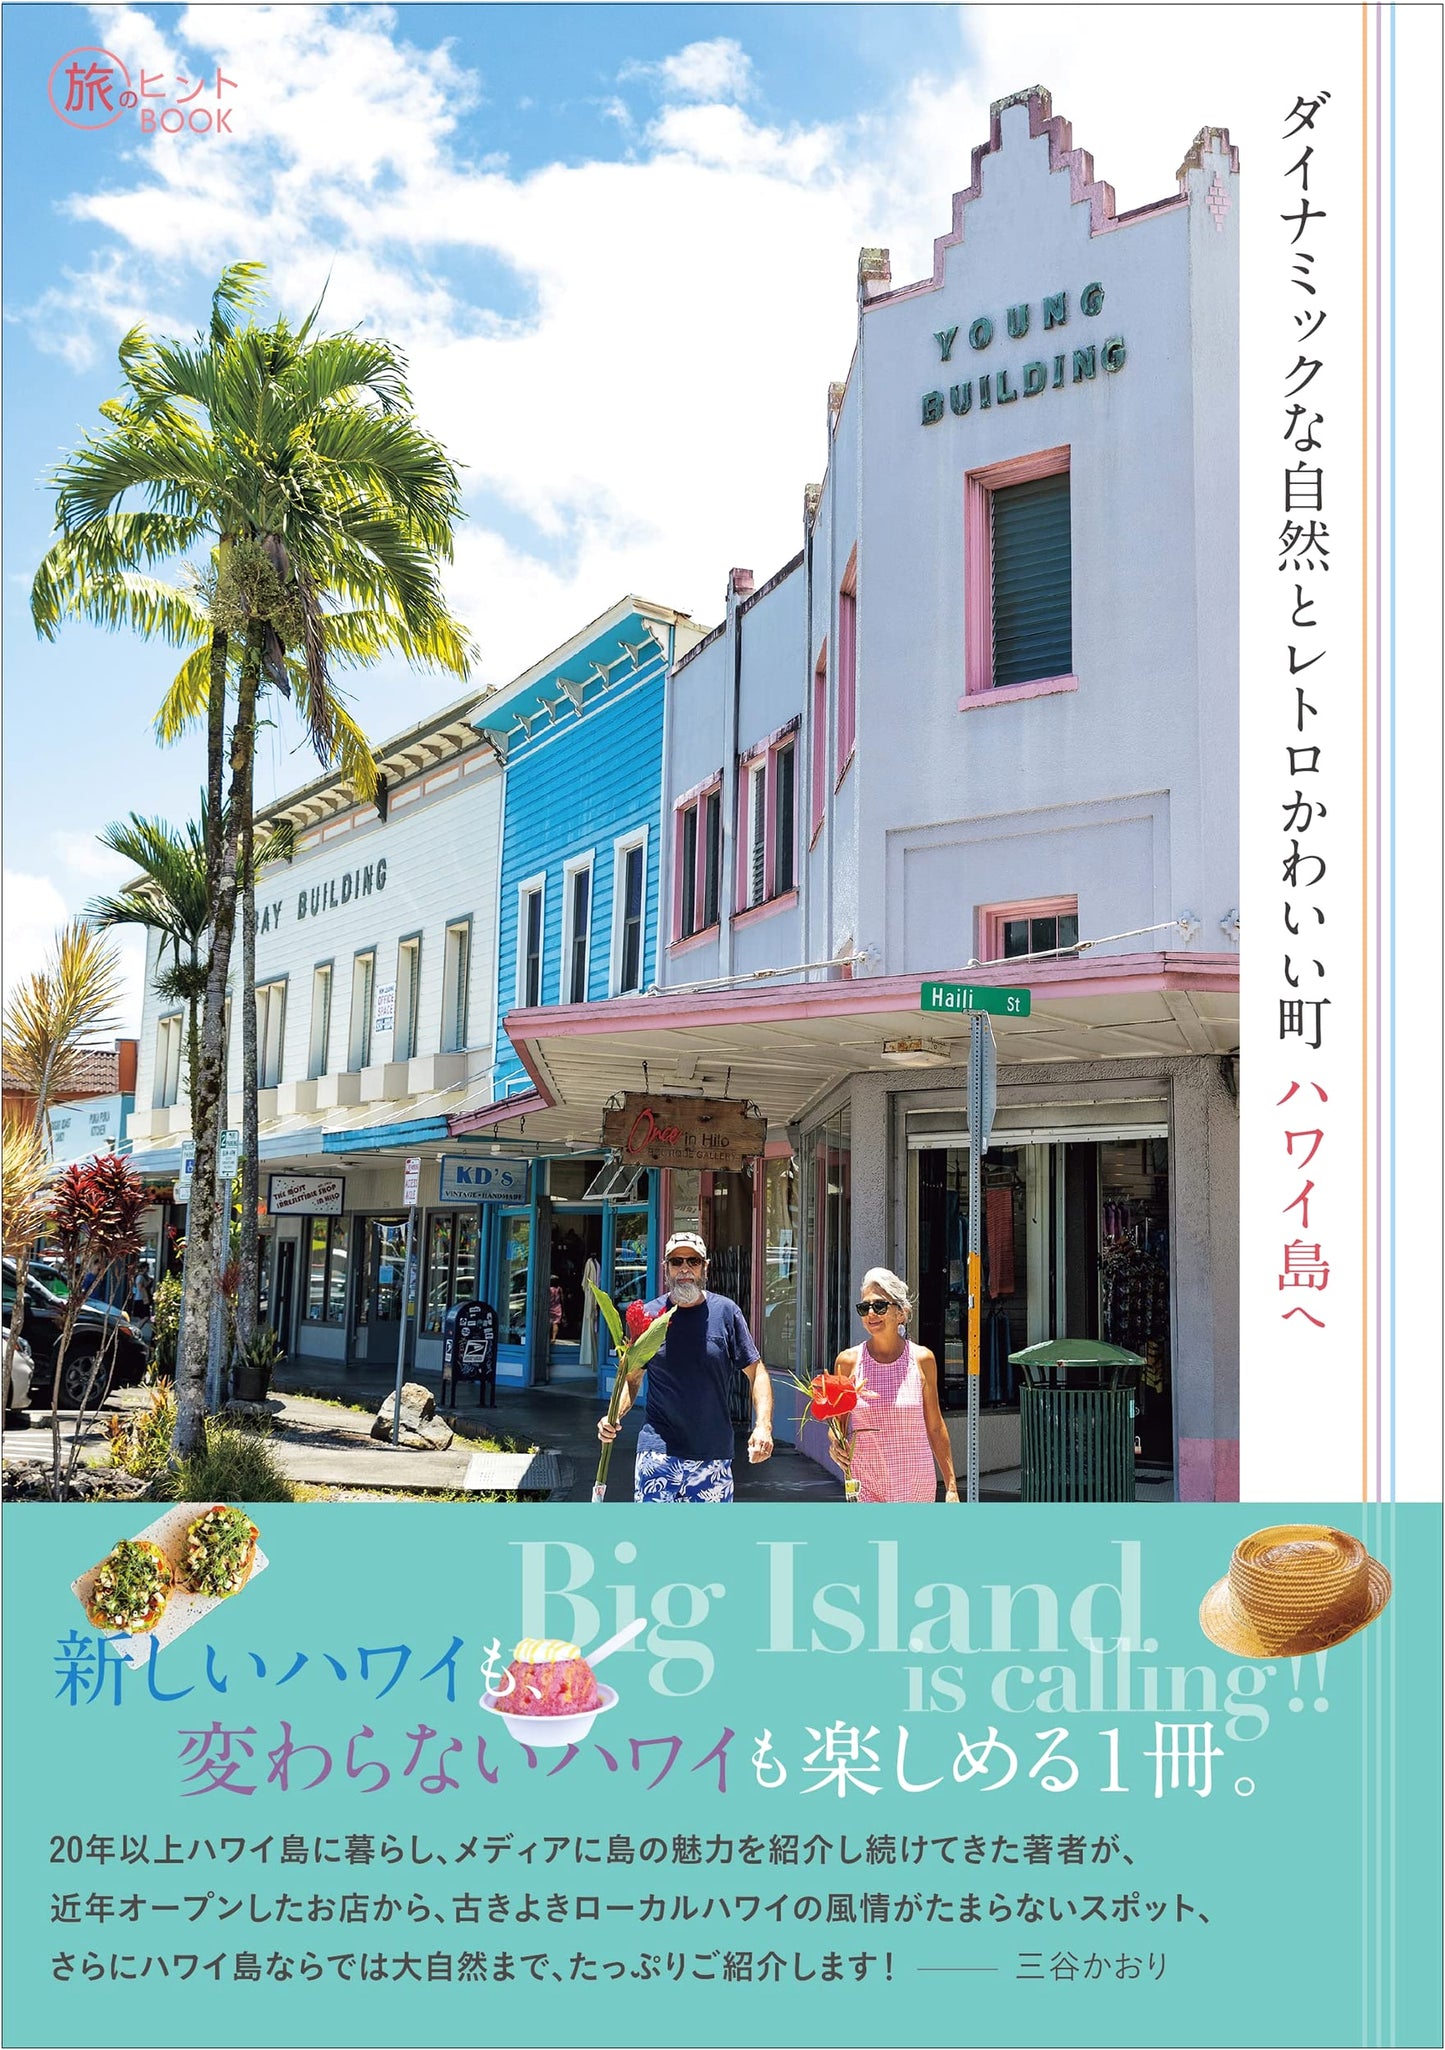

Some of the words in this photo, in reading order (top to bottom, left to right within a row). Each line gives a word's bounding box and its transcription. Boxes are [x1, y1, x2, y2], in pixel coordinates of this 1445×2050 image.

[933, 281, 1105, 361] YOUNG
[921, 336, 1126, 426] BUILDING
[297, 857, 387, 920] BUILDING
[932, 987, 973, 1009] Haili
[1006, 996, 1021, 1012] St
[627, 1108, 683, 1154] Once
[684, 1132, 697, 1145] in
[702, 1133, 730, 1147] Hilo
[696, 1151, 736, 1161] GALLERY
[456, 1166, 514, 1186] KD's
[273, 1191, 286, 1200] THE
[287, 1184, 306, 1195] MOST
[318, 1183, 336, 1195] SHOP
[325, 1192, 340, 1202] HILO
